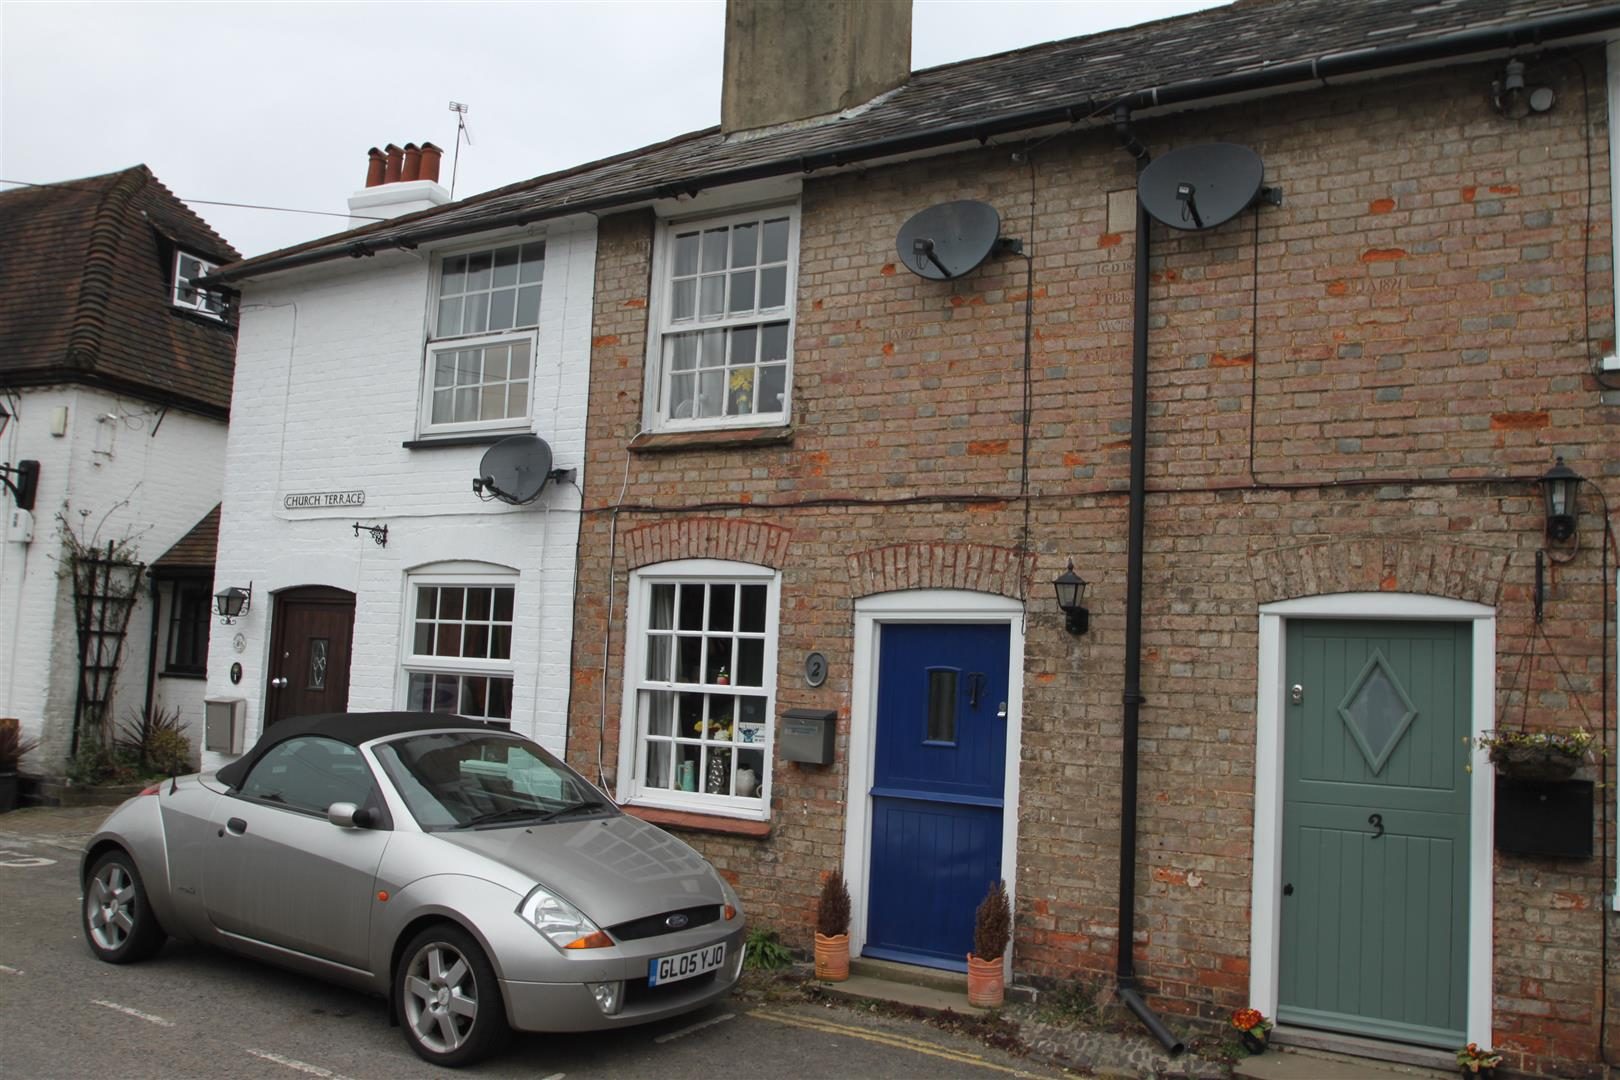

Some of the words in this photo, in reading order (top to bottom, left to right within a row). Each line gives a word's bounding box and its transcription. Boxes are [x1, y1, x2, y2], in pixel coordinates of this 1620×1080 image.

[285, 495, 321, 506] CHURCH
[324, 493, 362, 505] TERRACE
[811, 661, 821, 677] 2
[1367, 813, 1385, 839] 3
[659, 953, 698, 980] GL05
[701, 945, 723, 969] YJO
